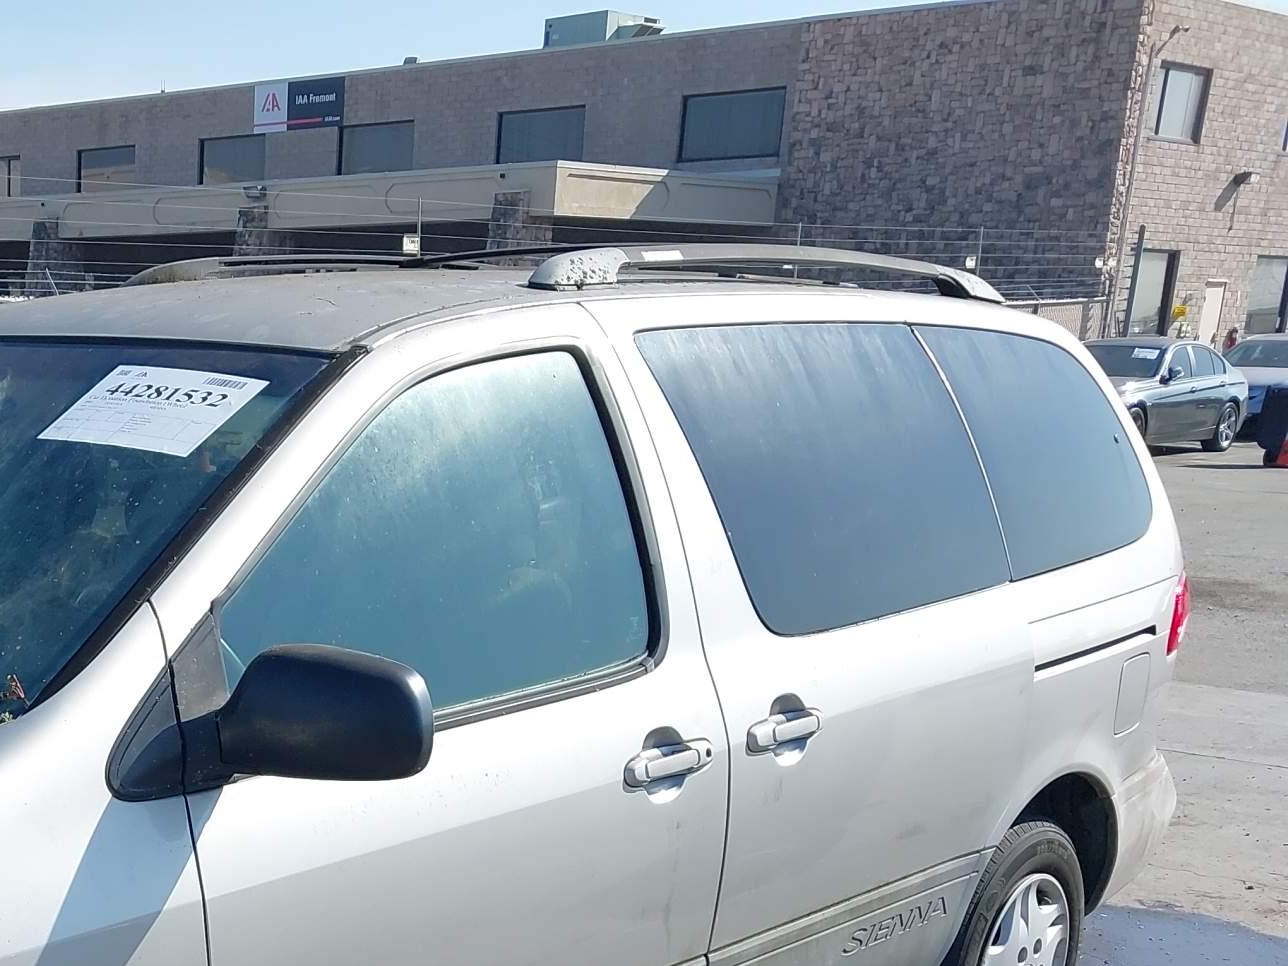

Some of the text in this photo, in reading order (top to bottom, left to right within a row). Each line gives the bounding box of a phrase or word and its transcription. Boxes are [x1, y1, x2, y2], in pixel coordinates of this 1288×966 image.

[295, 92, 336, 105] IAA Fremont
[106, 382, 229, 407] 44281532
[840, 896, 948, 956] SIENNA
